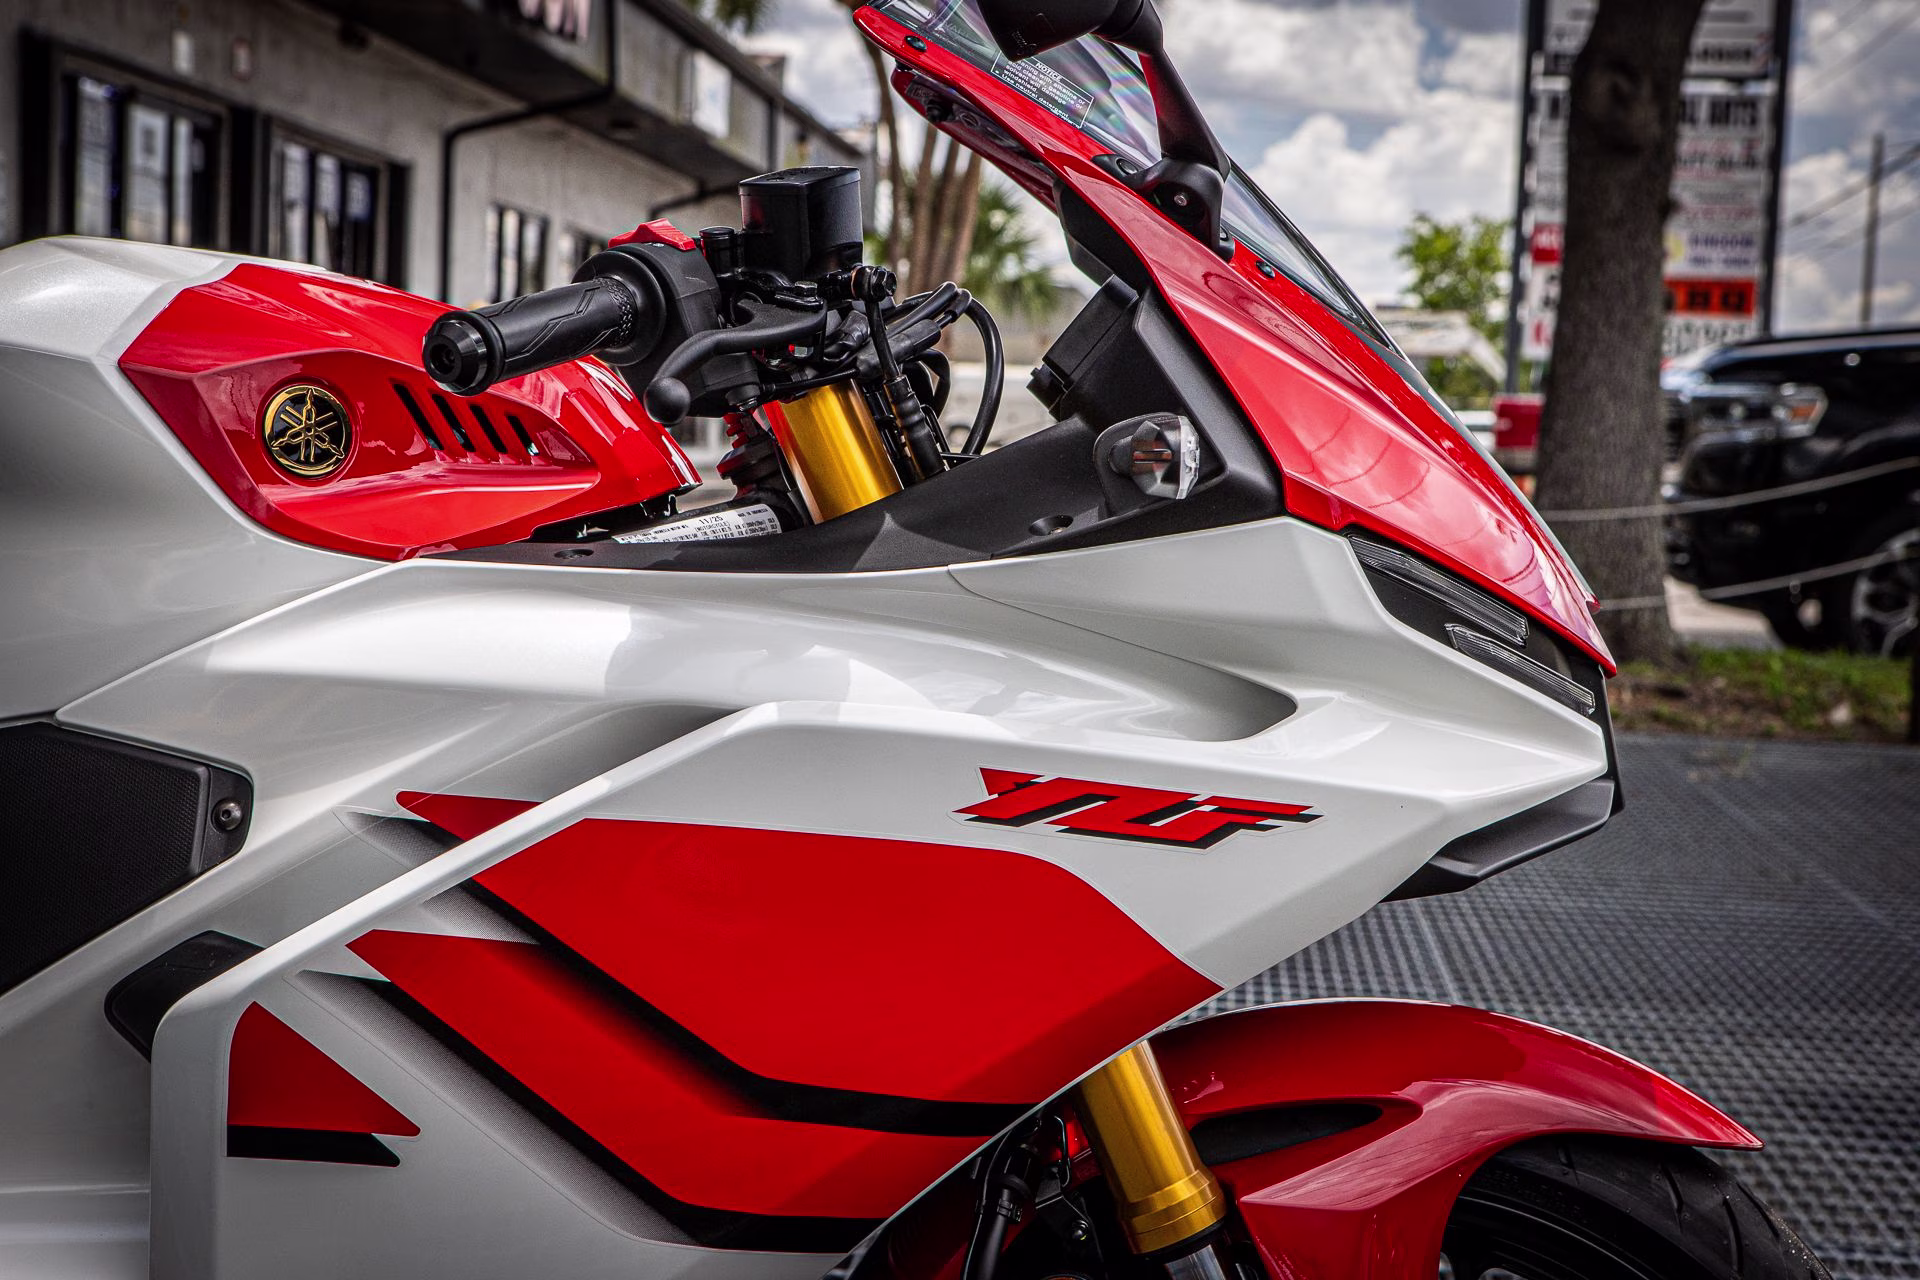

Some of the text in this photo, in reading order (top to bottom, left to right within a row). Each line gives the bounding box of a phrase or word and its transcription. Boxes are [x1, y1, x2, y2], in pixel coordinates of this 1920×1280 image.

[1035, 61, 1062, 81] NOTICE
[1005, 64, 1066, 106] solvent will damage
[1038, 72, 1052, 84] with
[1052, 81, 1077, 100] alkaline
[1047, 85, 1074, 105] gasoline
